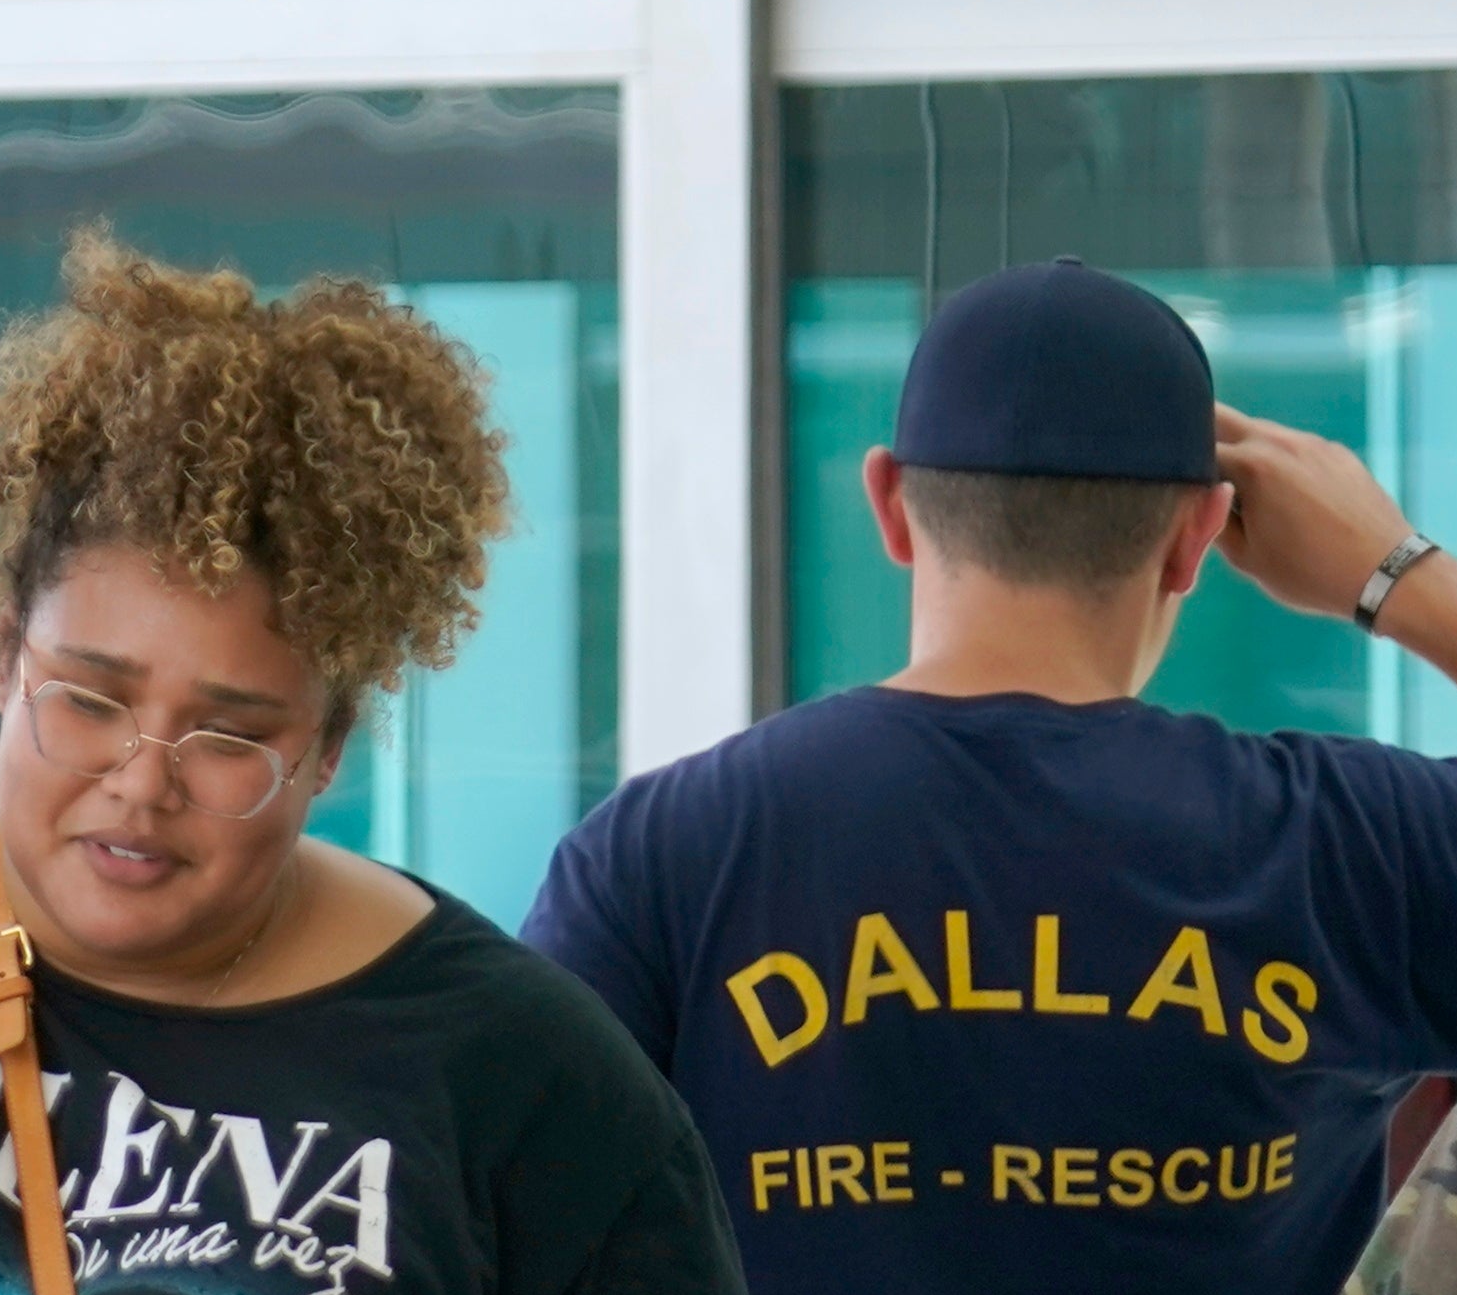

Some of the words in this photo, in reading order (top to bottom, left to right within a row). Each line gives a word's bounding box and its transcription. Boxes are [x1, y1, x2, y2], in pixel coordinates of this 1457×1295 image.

[725, 909, 1318, 1068] DALLAS
[751, 1141, 914, 1211] FIRE
[992, 1133, 1298, 1207] RESCUE
[120, 1221, 240, 1270] una
